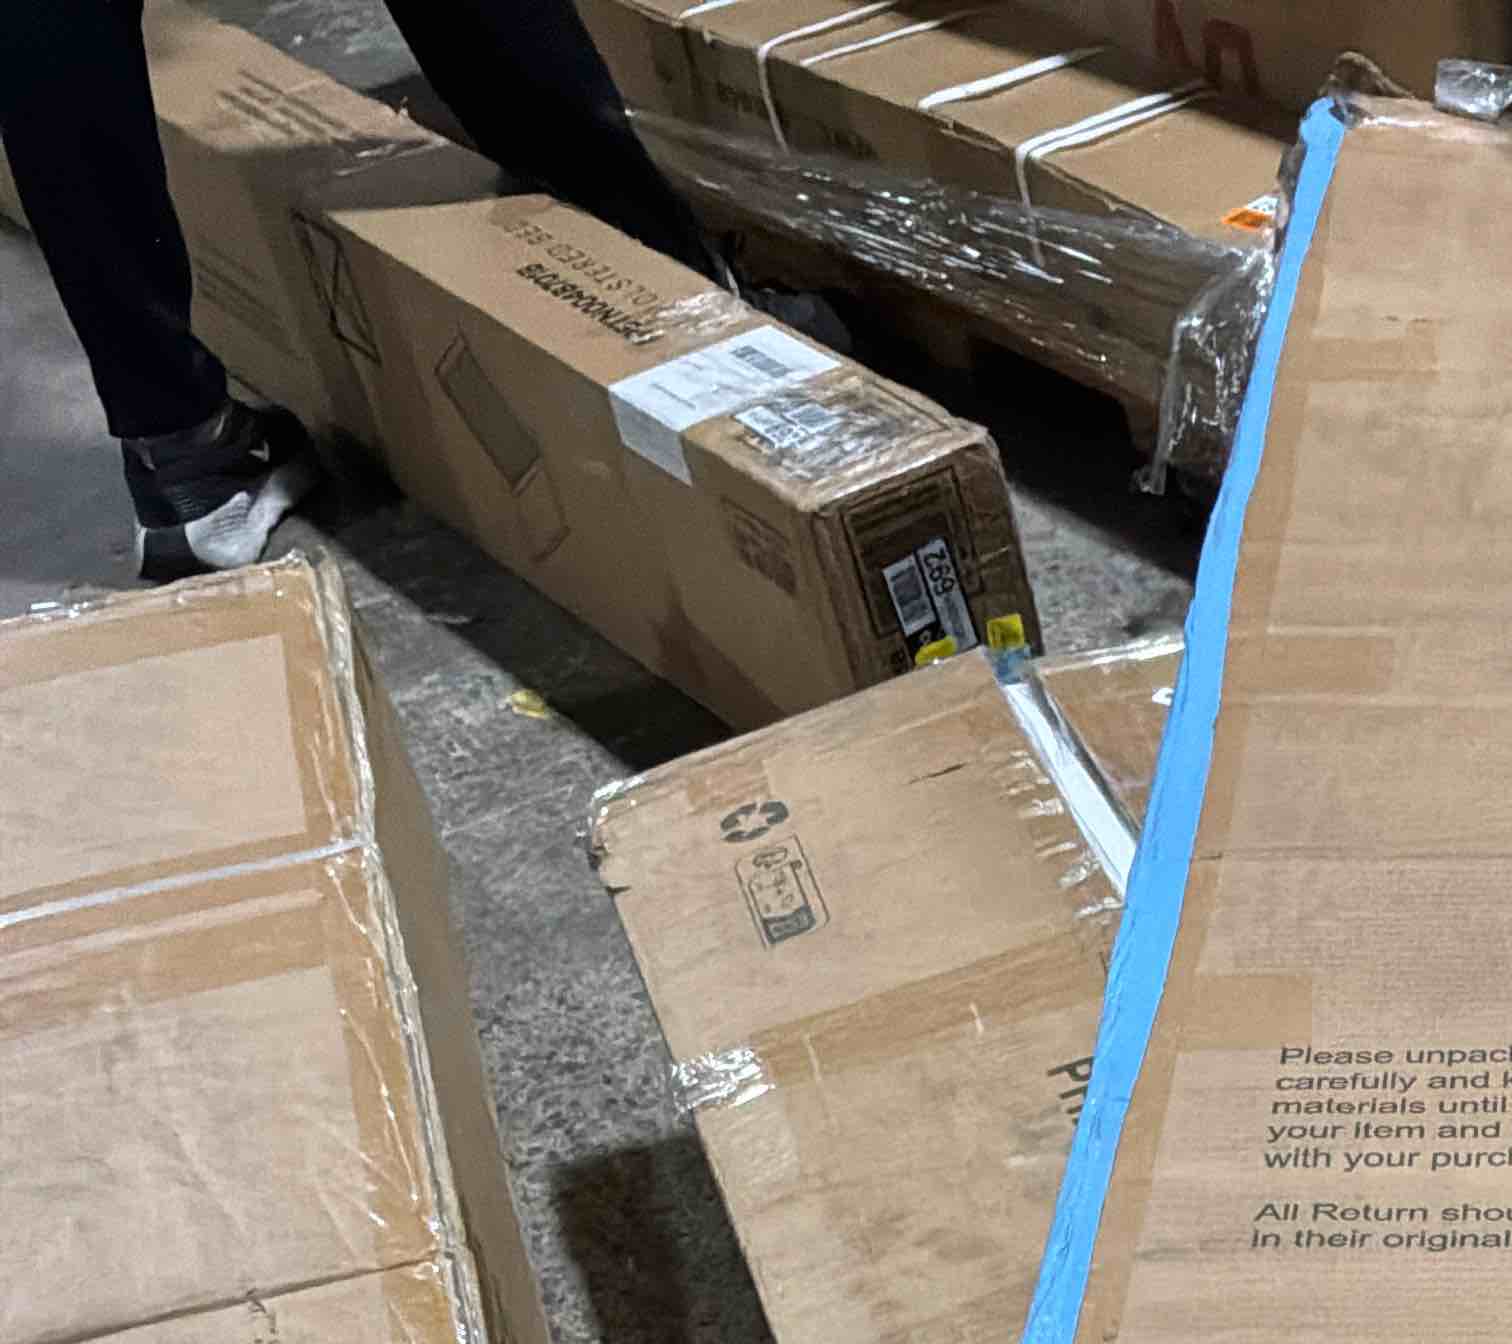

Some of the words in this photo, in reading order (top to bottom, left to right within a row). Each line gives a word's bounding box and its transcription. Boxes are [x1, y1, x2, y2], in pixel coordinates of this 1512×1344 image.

[1280, 1047, 1394, 1065] Please
[1275, 1071, 1417, 1092] carefully
[1428, 1072, 1490, 1089] and
[1272, 1098, 1426, 1115] materials
[1438, 1096, 1507, 1114] until
[1267, 1124, 1344, 1143] your
[1354, 1121, 1425, 1139] item
[1437, 1122, 1501, 1139] and
[1264, 1148, 1331, 1168] with
[1343, 1151, 1420, 1172] your
[1254, 1203, 1298, 1222] All
[1311, 1203, 1428, 1222] Return
[1294, 1229, 1373, 1248] their
[1382, 1230, 1511, 1252] original
